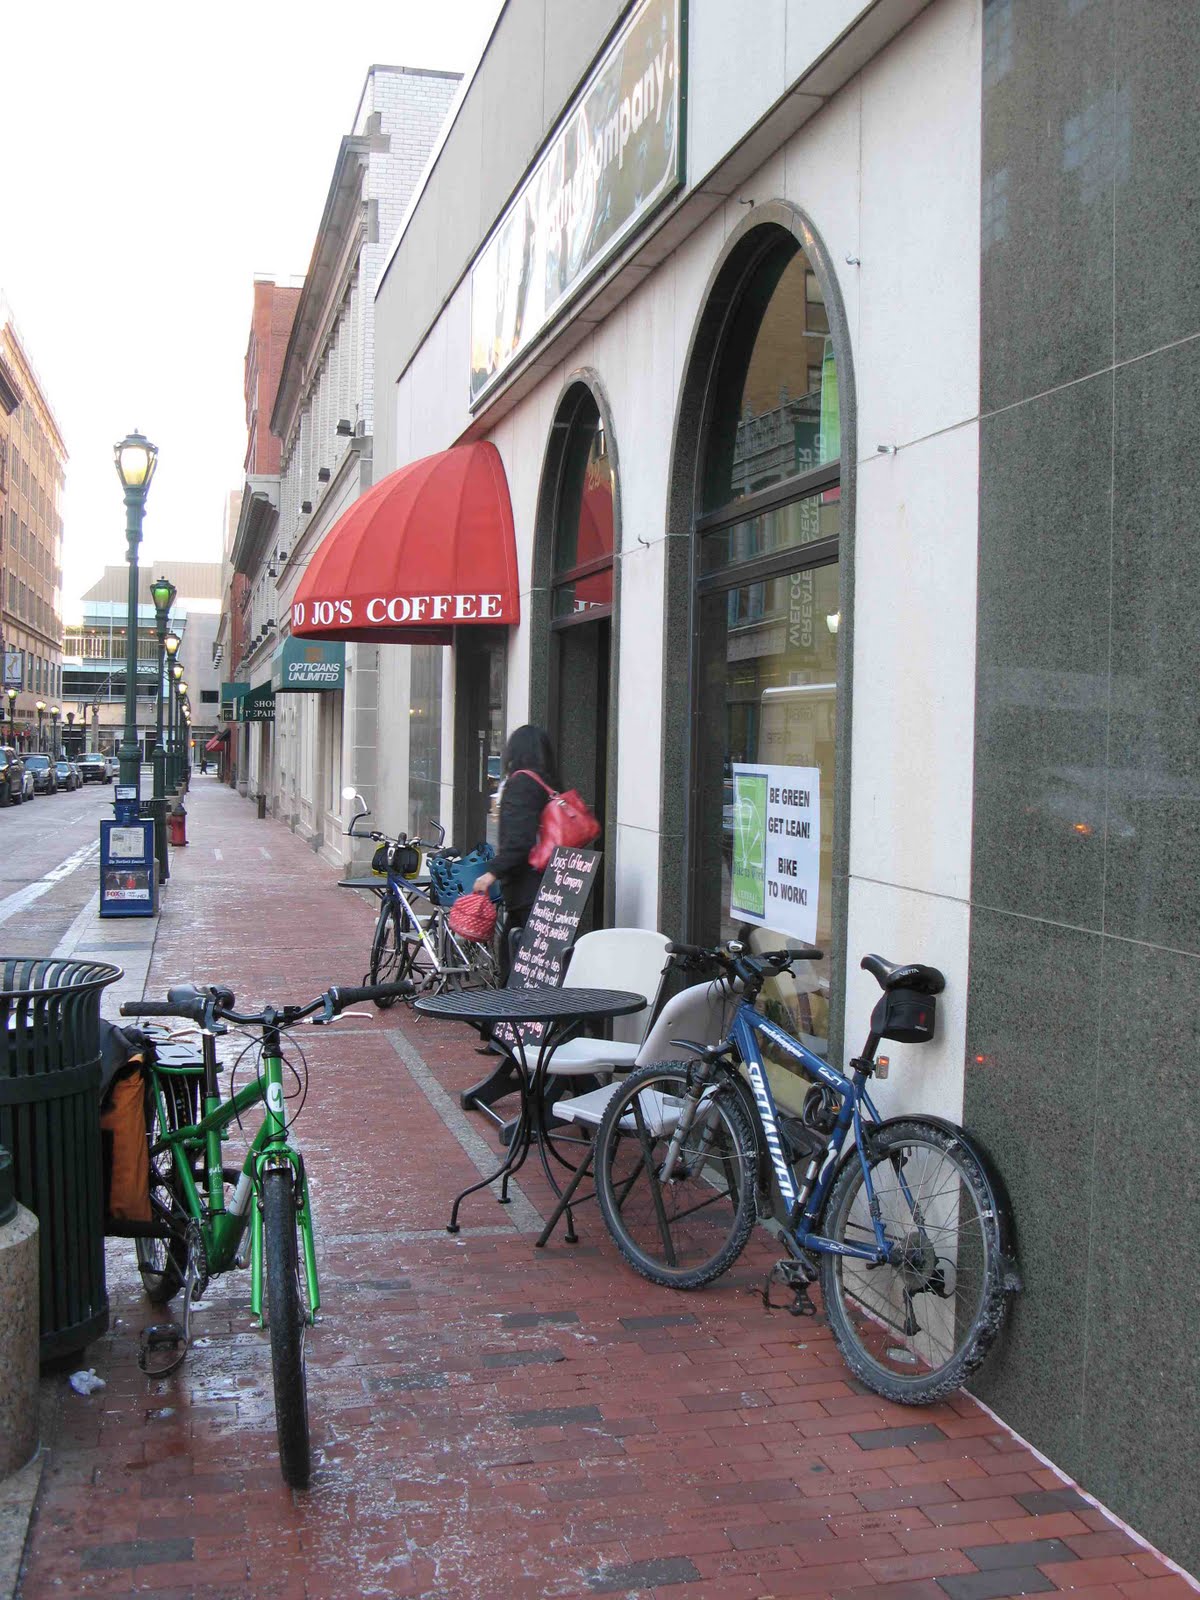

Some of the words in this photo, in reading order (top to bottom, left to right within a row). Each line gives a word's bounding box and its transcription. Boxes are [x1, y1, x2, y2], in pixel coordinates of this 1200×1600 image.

[311, 600, 353, 625] JO'S
[366, 594, 503, 622] COFFEE
[288, 662, 341, 672] OPTICIANS
[288, 672, 339, 682] UNLIMITED
[769, 787, 780, 804] BE
[781, 788, 810, 808] GREEN
[767, 816, 784, 835] GET
[785, 818, 811, 840] LEAN!
[777, 856, 798, 878] BIKE
[562, 872, 584, 895] Company
[767, 880, 779, 898] TO
[780, 883, 808, 906] WORK!
[538, 885, 564, 906] Sandwiches
